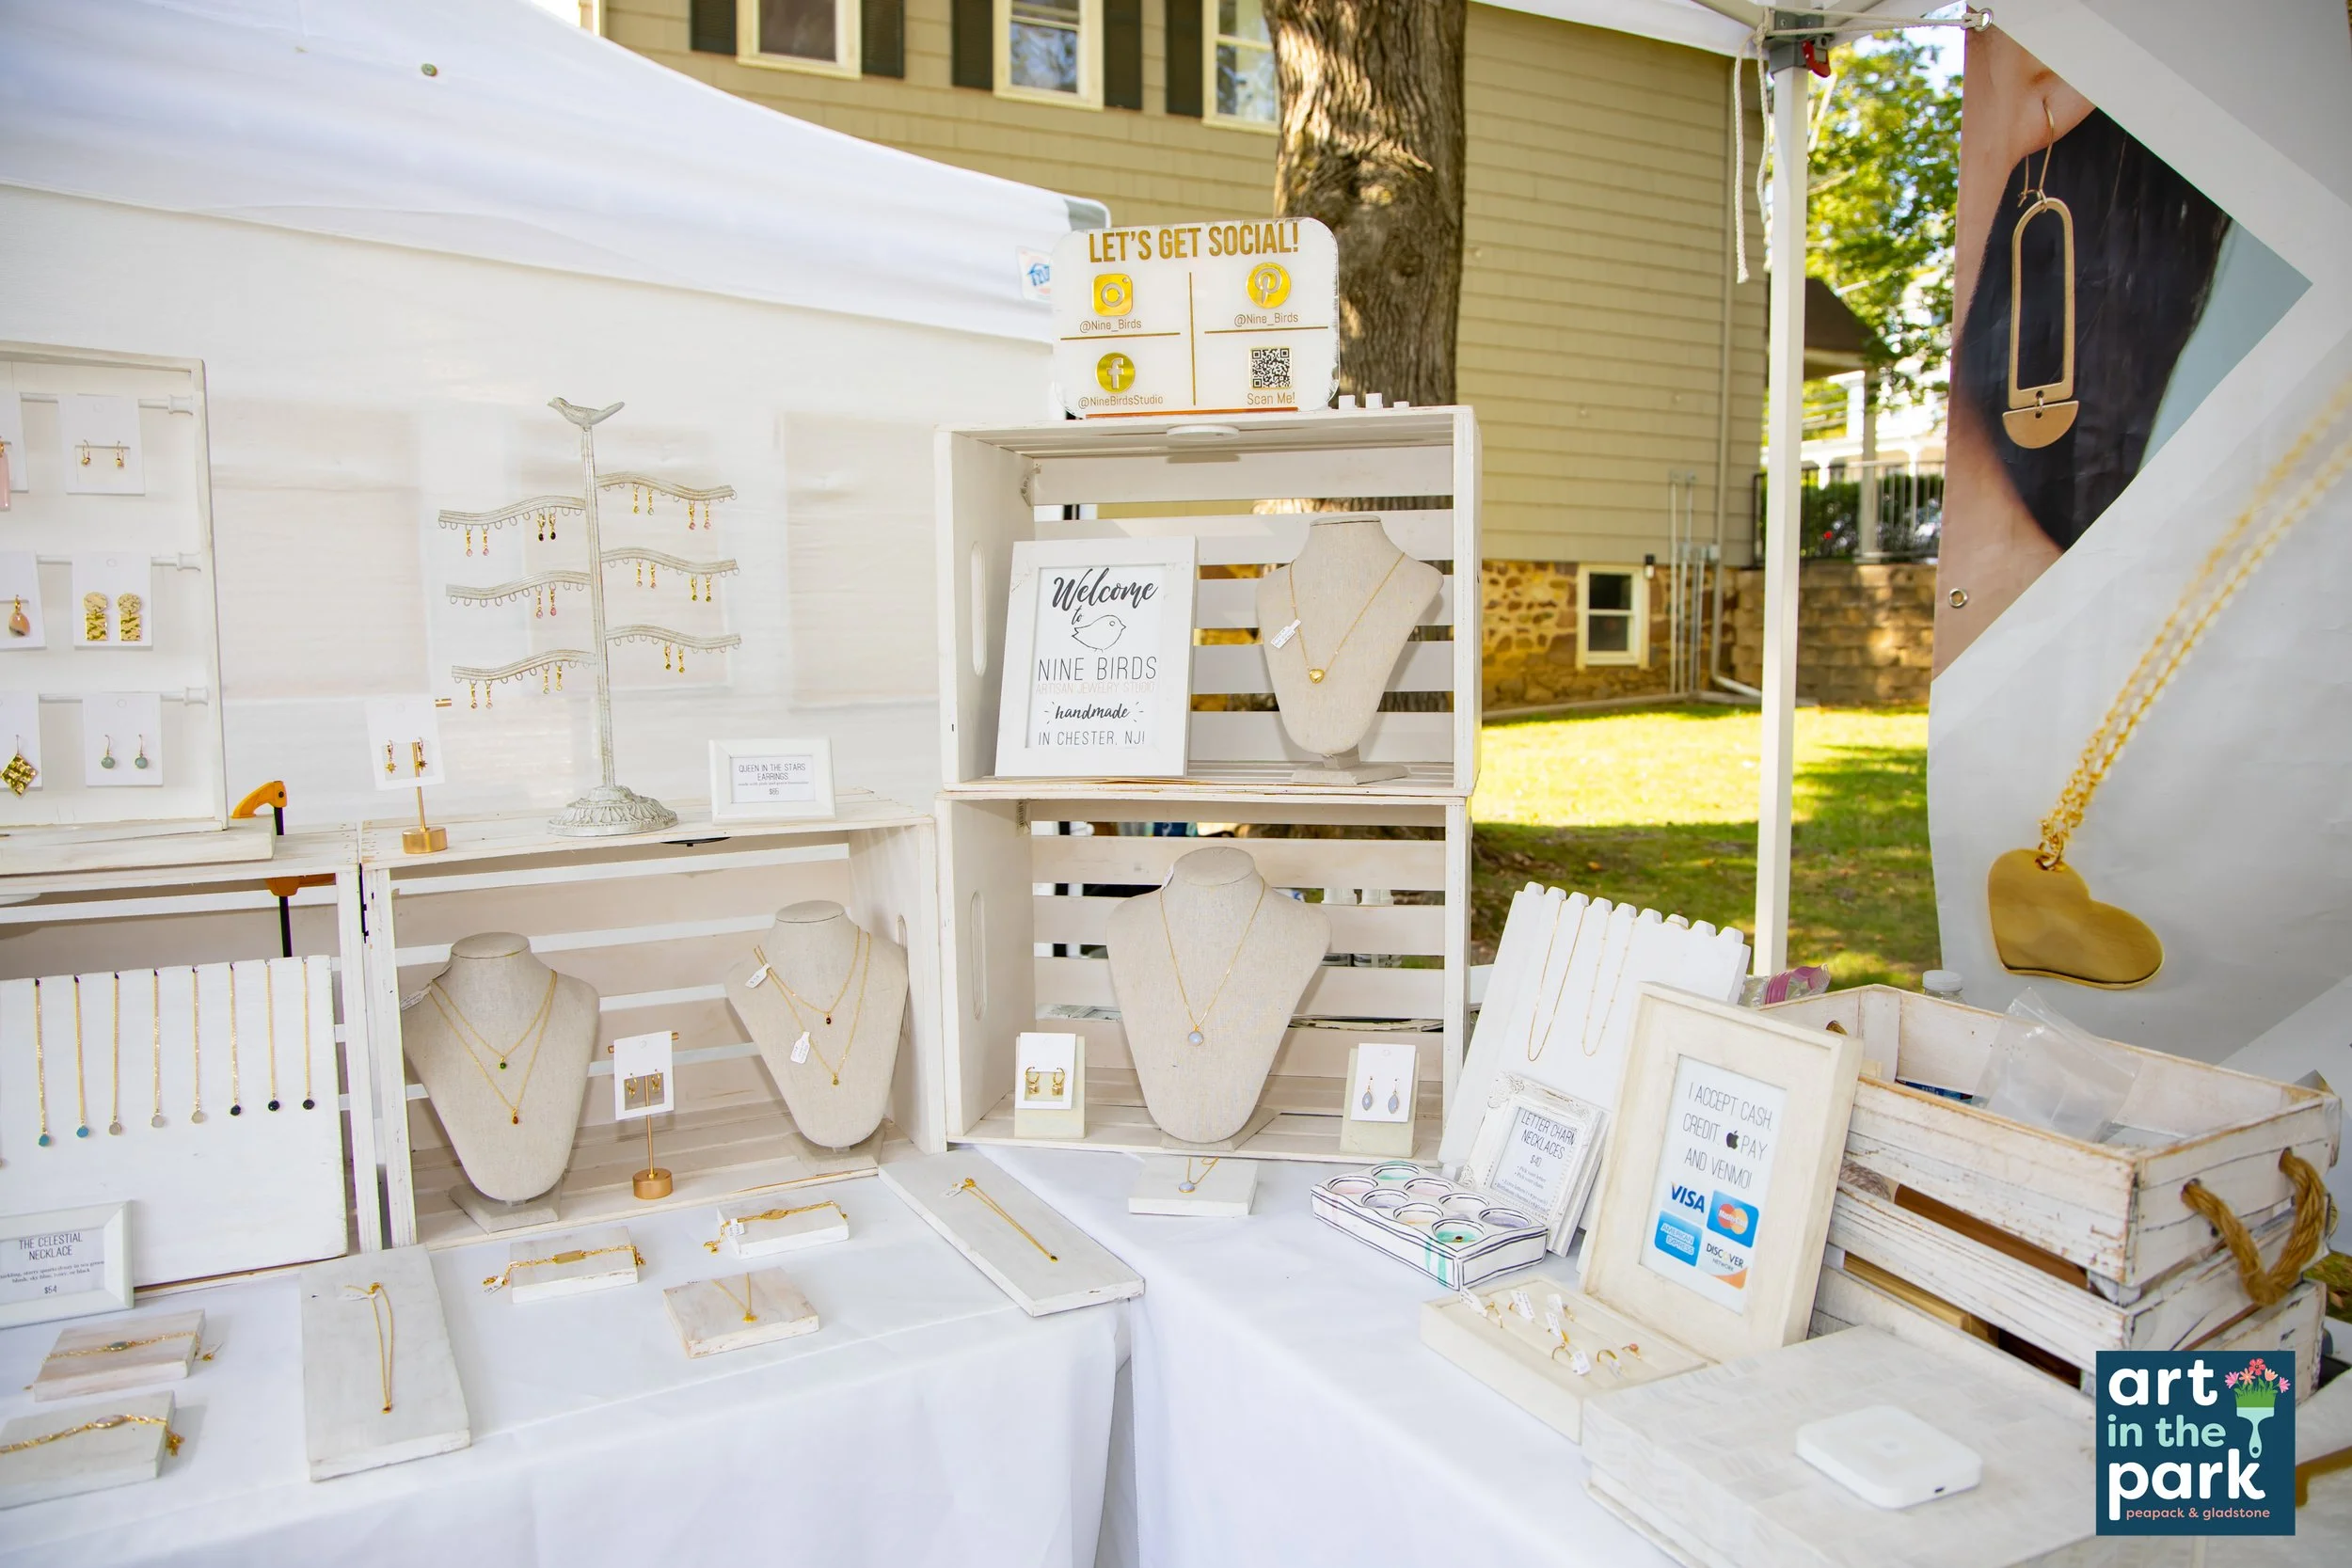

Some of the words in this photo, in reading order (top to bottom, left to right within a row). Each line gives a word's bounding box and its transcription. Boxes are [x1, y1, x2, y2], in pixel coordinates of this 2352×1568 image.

[1089, 231, 1152, 263] LET'S
[1159, 228, 1201, 259] GET
[1208, 222, 1299, 257] SOCIAL!
[1079, 318, 1142, 333] @Nine_Birds
[1234, 312, 1298, 326] @Nine_Birds
[1077, 394, 1164, 409] @NineBirdsStudio
[1247, 393, 1274, 405] Scan
[1277, 392, 1295, 404] Me!
[1052, 567, 1158, 611] Welcome
[1071, 605, 1084, 625] to
[1038, 657, 1085, 681] NINE
[1096, 656, 1157, 680] BIRDS
[1036, 682, 1073, 695] ARTISAN
[1077, 681, 1119, 694] JEWELRY
[1123, 680, 1155, 693] STUDIO
[1055, 703, 1130, 720] handmade
[1038, 732, 1050, 746] IN
[1057, 730, 1118, 746] CHESTER,
[1124, 730, 1145, 745] NJ!
[739, 764, 759, 772] QUEEN
[770, 763, 782, 771] THE
[784, 763, 806, 771] STARS
[757, 772, 788, 782] EARRINGS
[1689, 1082, 1694, 1099] I
[1694, 1085, 1739, 1116] ACCEPT
[1740, 1101, 1773, 1132] CASH,
[1520, 1110, 1550, 1135] LETTER
[1520, 1129, 1565, 1160] NECKLACES
[1682, 1113, 1721, 1146] CREDIT,
[1740, 1134, 1768, 1161] PAY
[1684, 1148, 1708, 1171] AND
[1711, 1156, 1753, 1189] VENMO!
[1671, 1181, 1706, 1213] VISA
[19, 1237, 35, 1250] THE
[38, 1232, 83, 1247] CELESTIAL
[1661, 1223, 1694, 1244] AMERICAN
[28, 1244, 73, 1261] NECKLACE
[1666, 1236, 1694, 1255] EXPRESS
